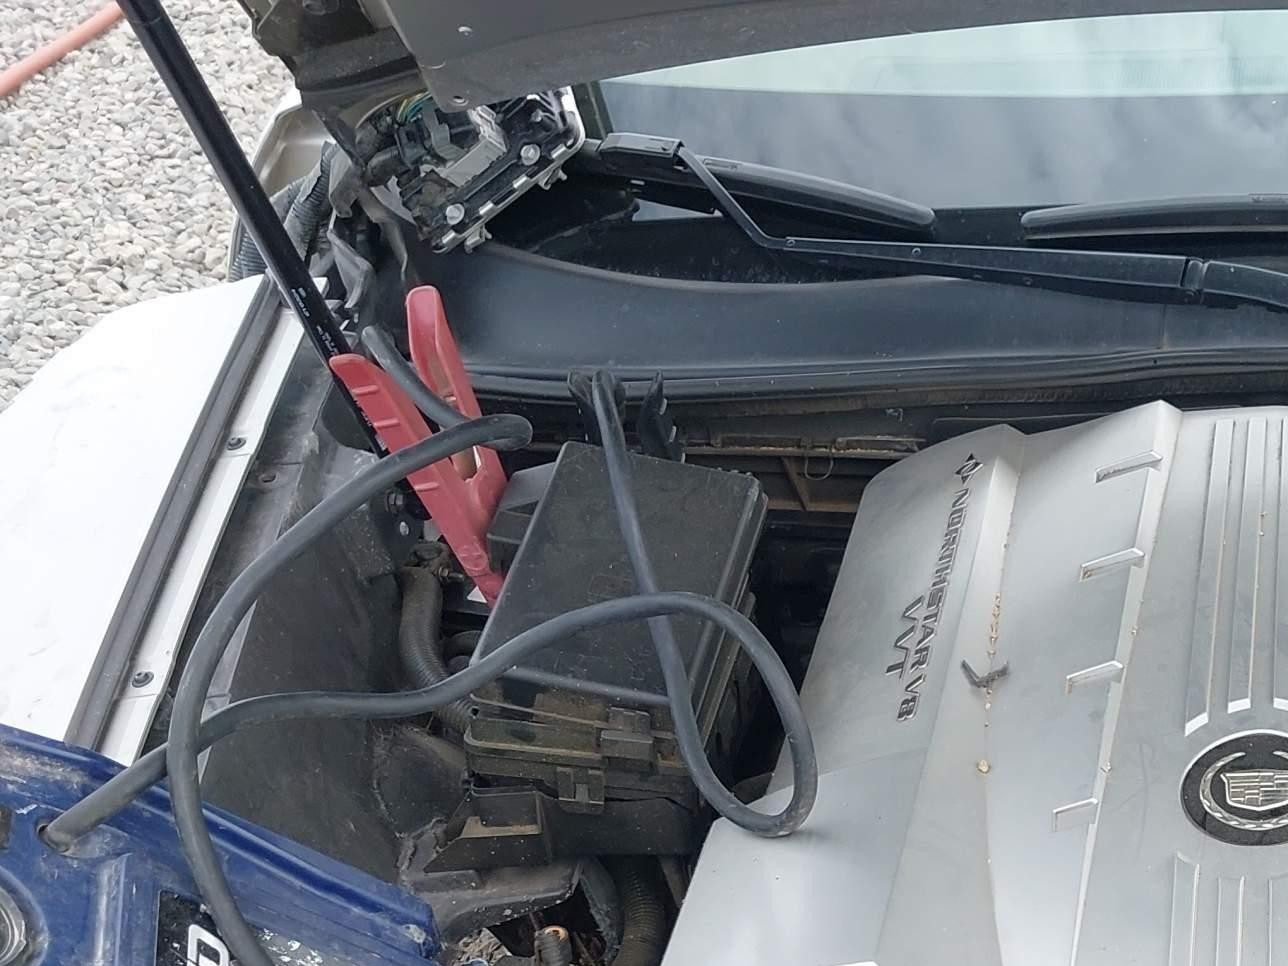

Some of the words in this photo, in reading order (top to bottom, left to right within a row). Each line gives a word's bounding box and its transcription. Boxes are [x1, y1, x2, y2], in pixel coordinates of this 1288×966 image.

[910, 487, 970, 674] NORTHSTAR
[885, 594, 924, 679] VVT
[897, 673, 926, 721] V8
